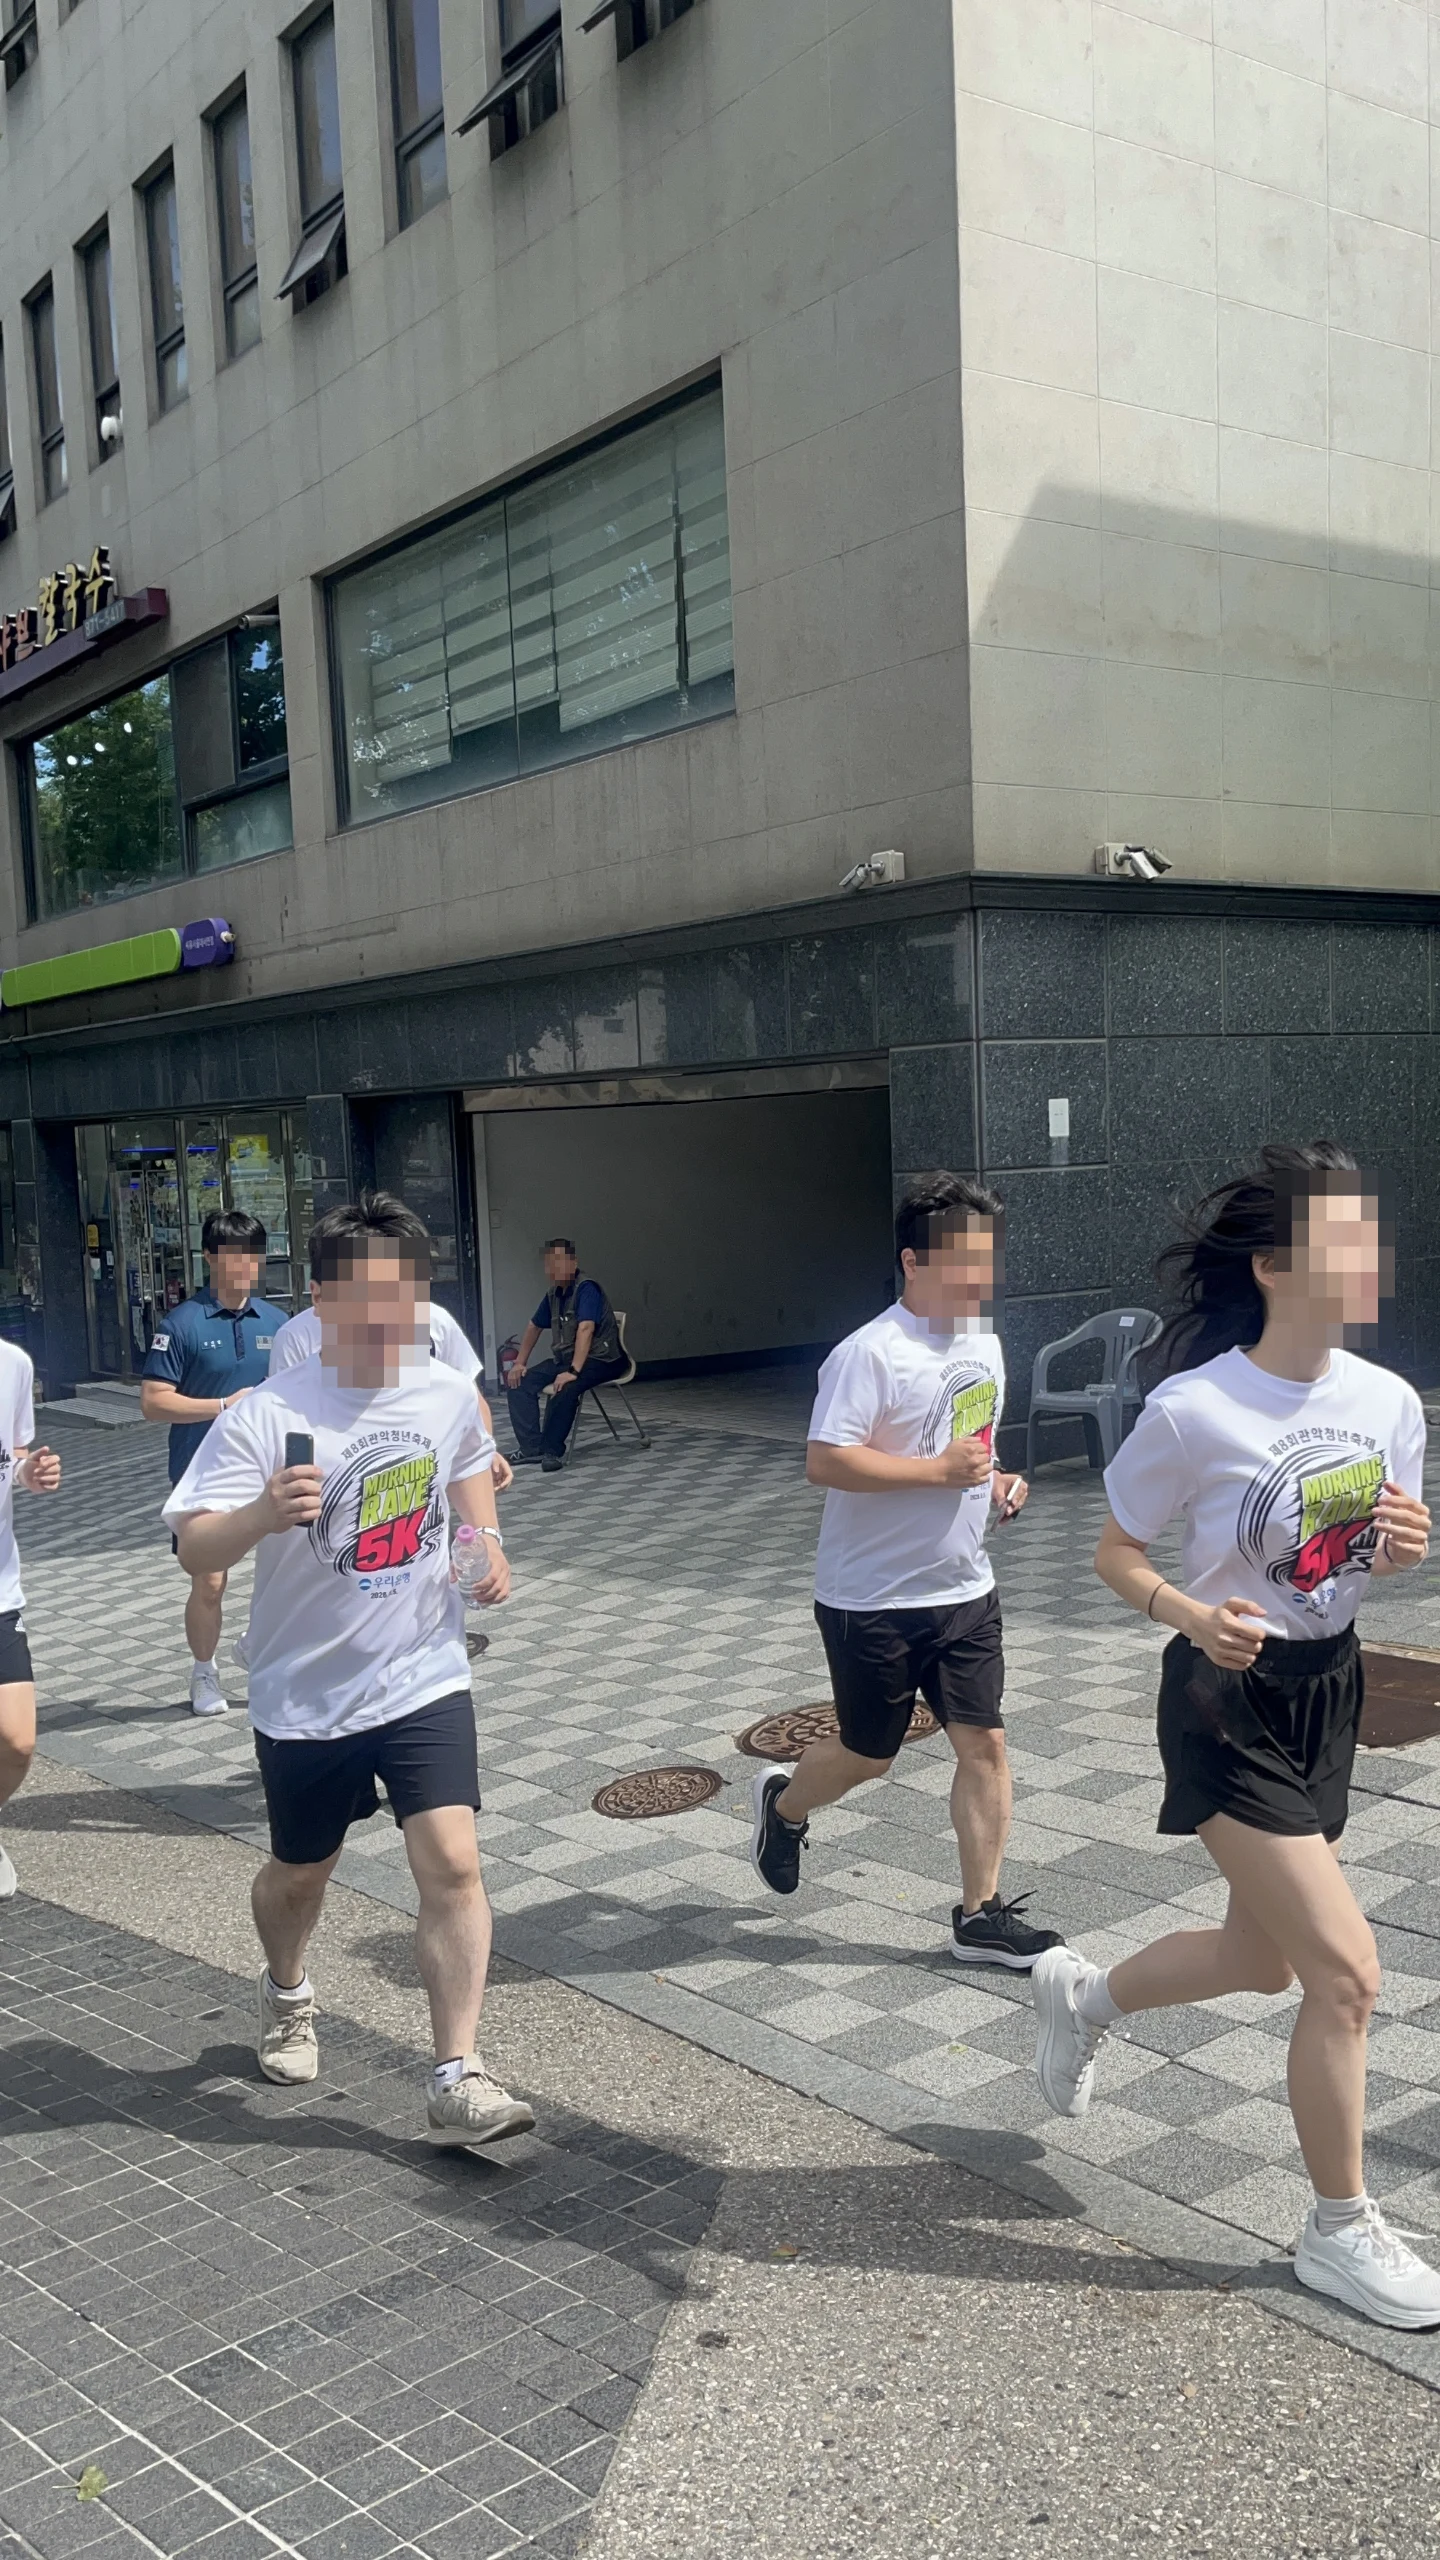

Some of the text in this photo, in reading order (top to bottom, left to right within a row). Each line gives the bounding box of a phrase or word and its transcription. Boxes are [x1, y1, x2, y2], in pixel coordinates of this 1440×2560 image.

[363, 1452, 436, 1497] MORNING
[1301, 1454, 1383, 1507] MORNING
[360, 1479, 430, 1530] RAVE
[1301, 1485, 1378, 1542] RAVE
[355, 1507, 428, 1572] 5K
[1292, 1519, 1373, 1592] 5K
[373, 1571, 411, 1588] 우리은행
